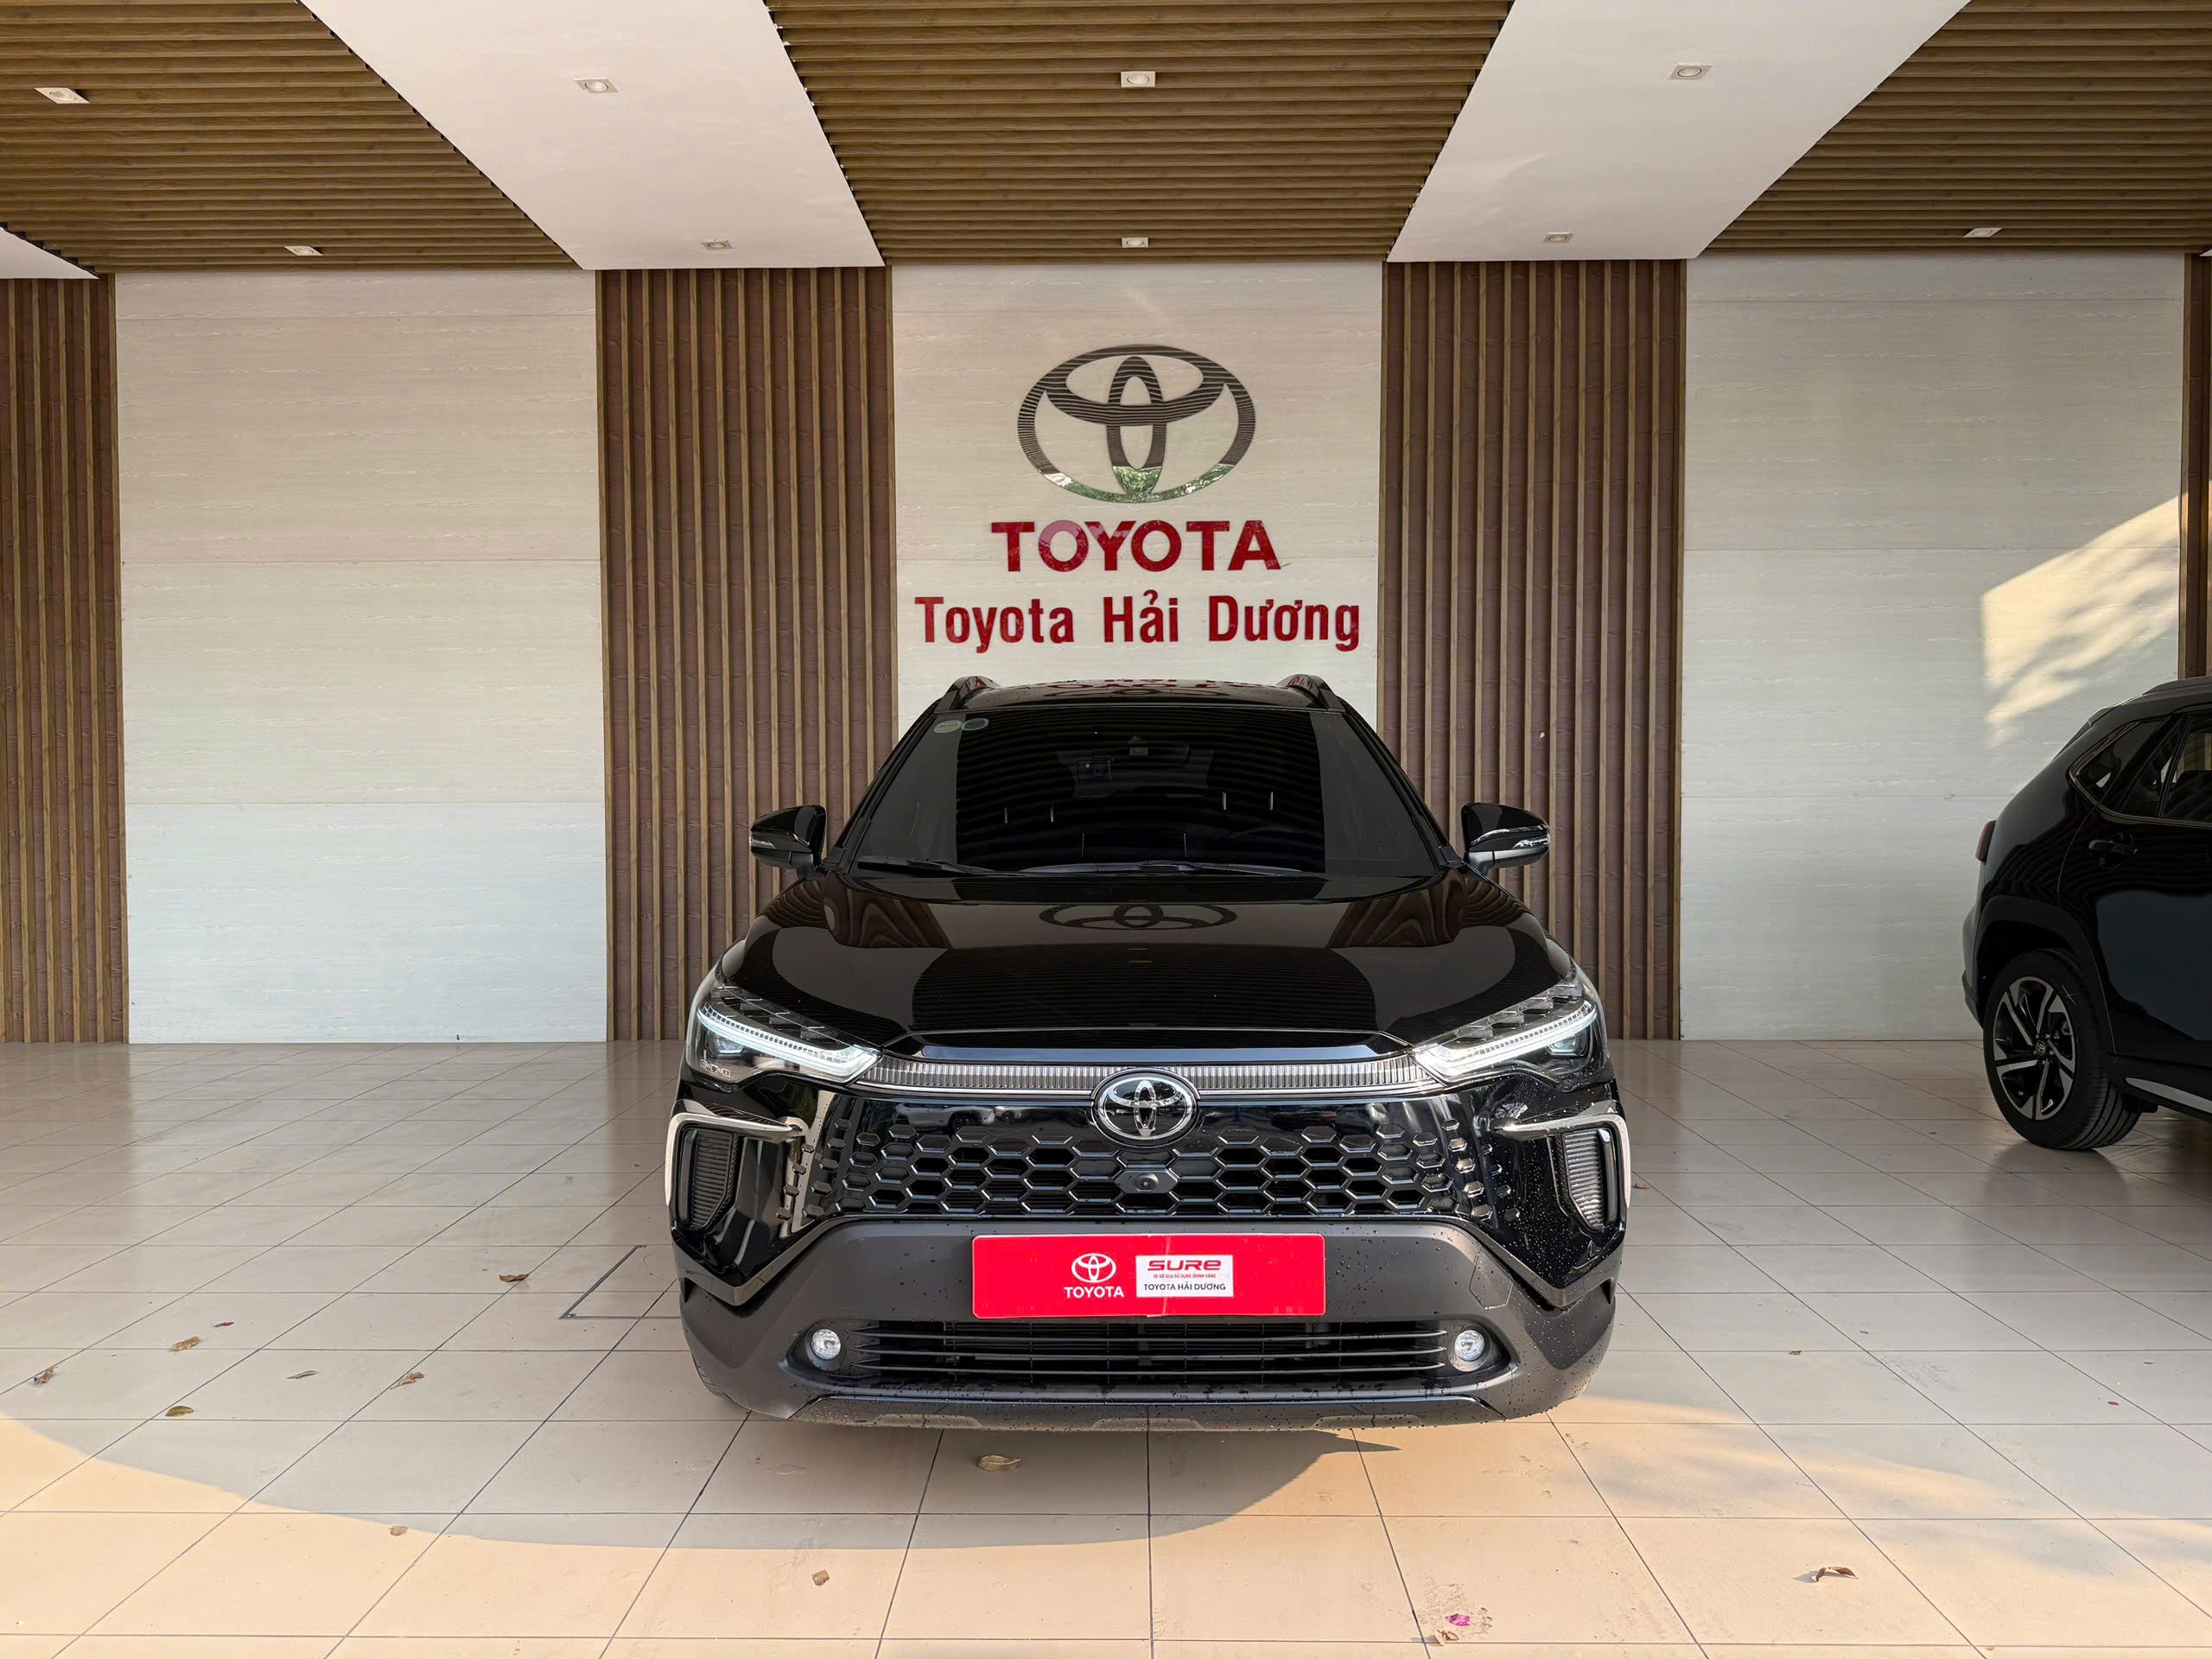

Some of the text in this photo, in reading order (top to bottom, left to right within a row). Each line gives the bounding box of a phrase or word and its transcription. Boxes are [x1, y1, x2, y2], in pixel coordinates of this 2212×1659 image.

[991, 520, 1281, 573] TOYOTA
[914, 589, 1360, 653] Toyota Hải Dương
[1065, 1286, 1125, 1299] TOYOTA
[1178, 1281, 1192, 1291] HẢI
[1194, 1282, 1226, 1291] DƯƠNG
